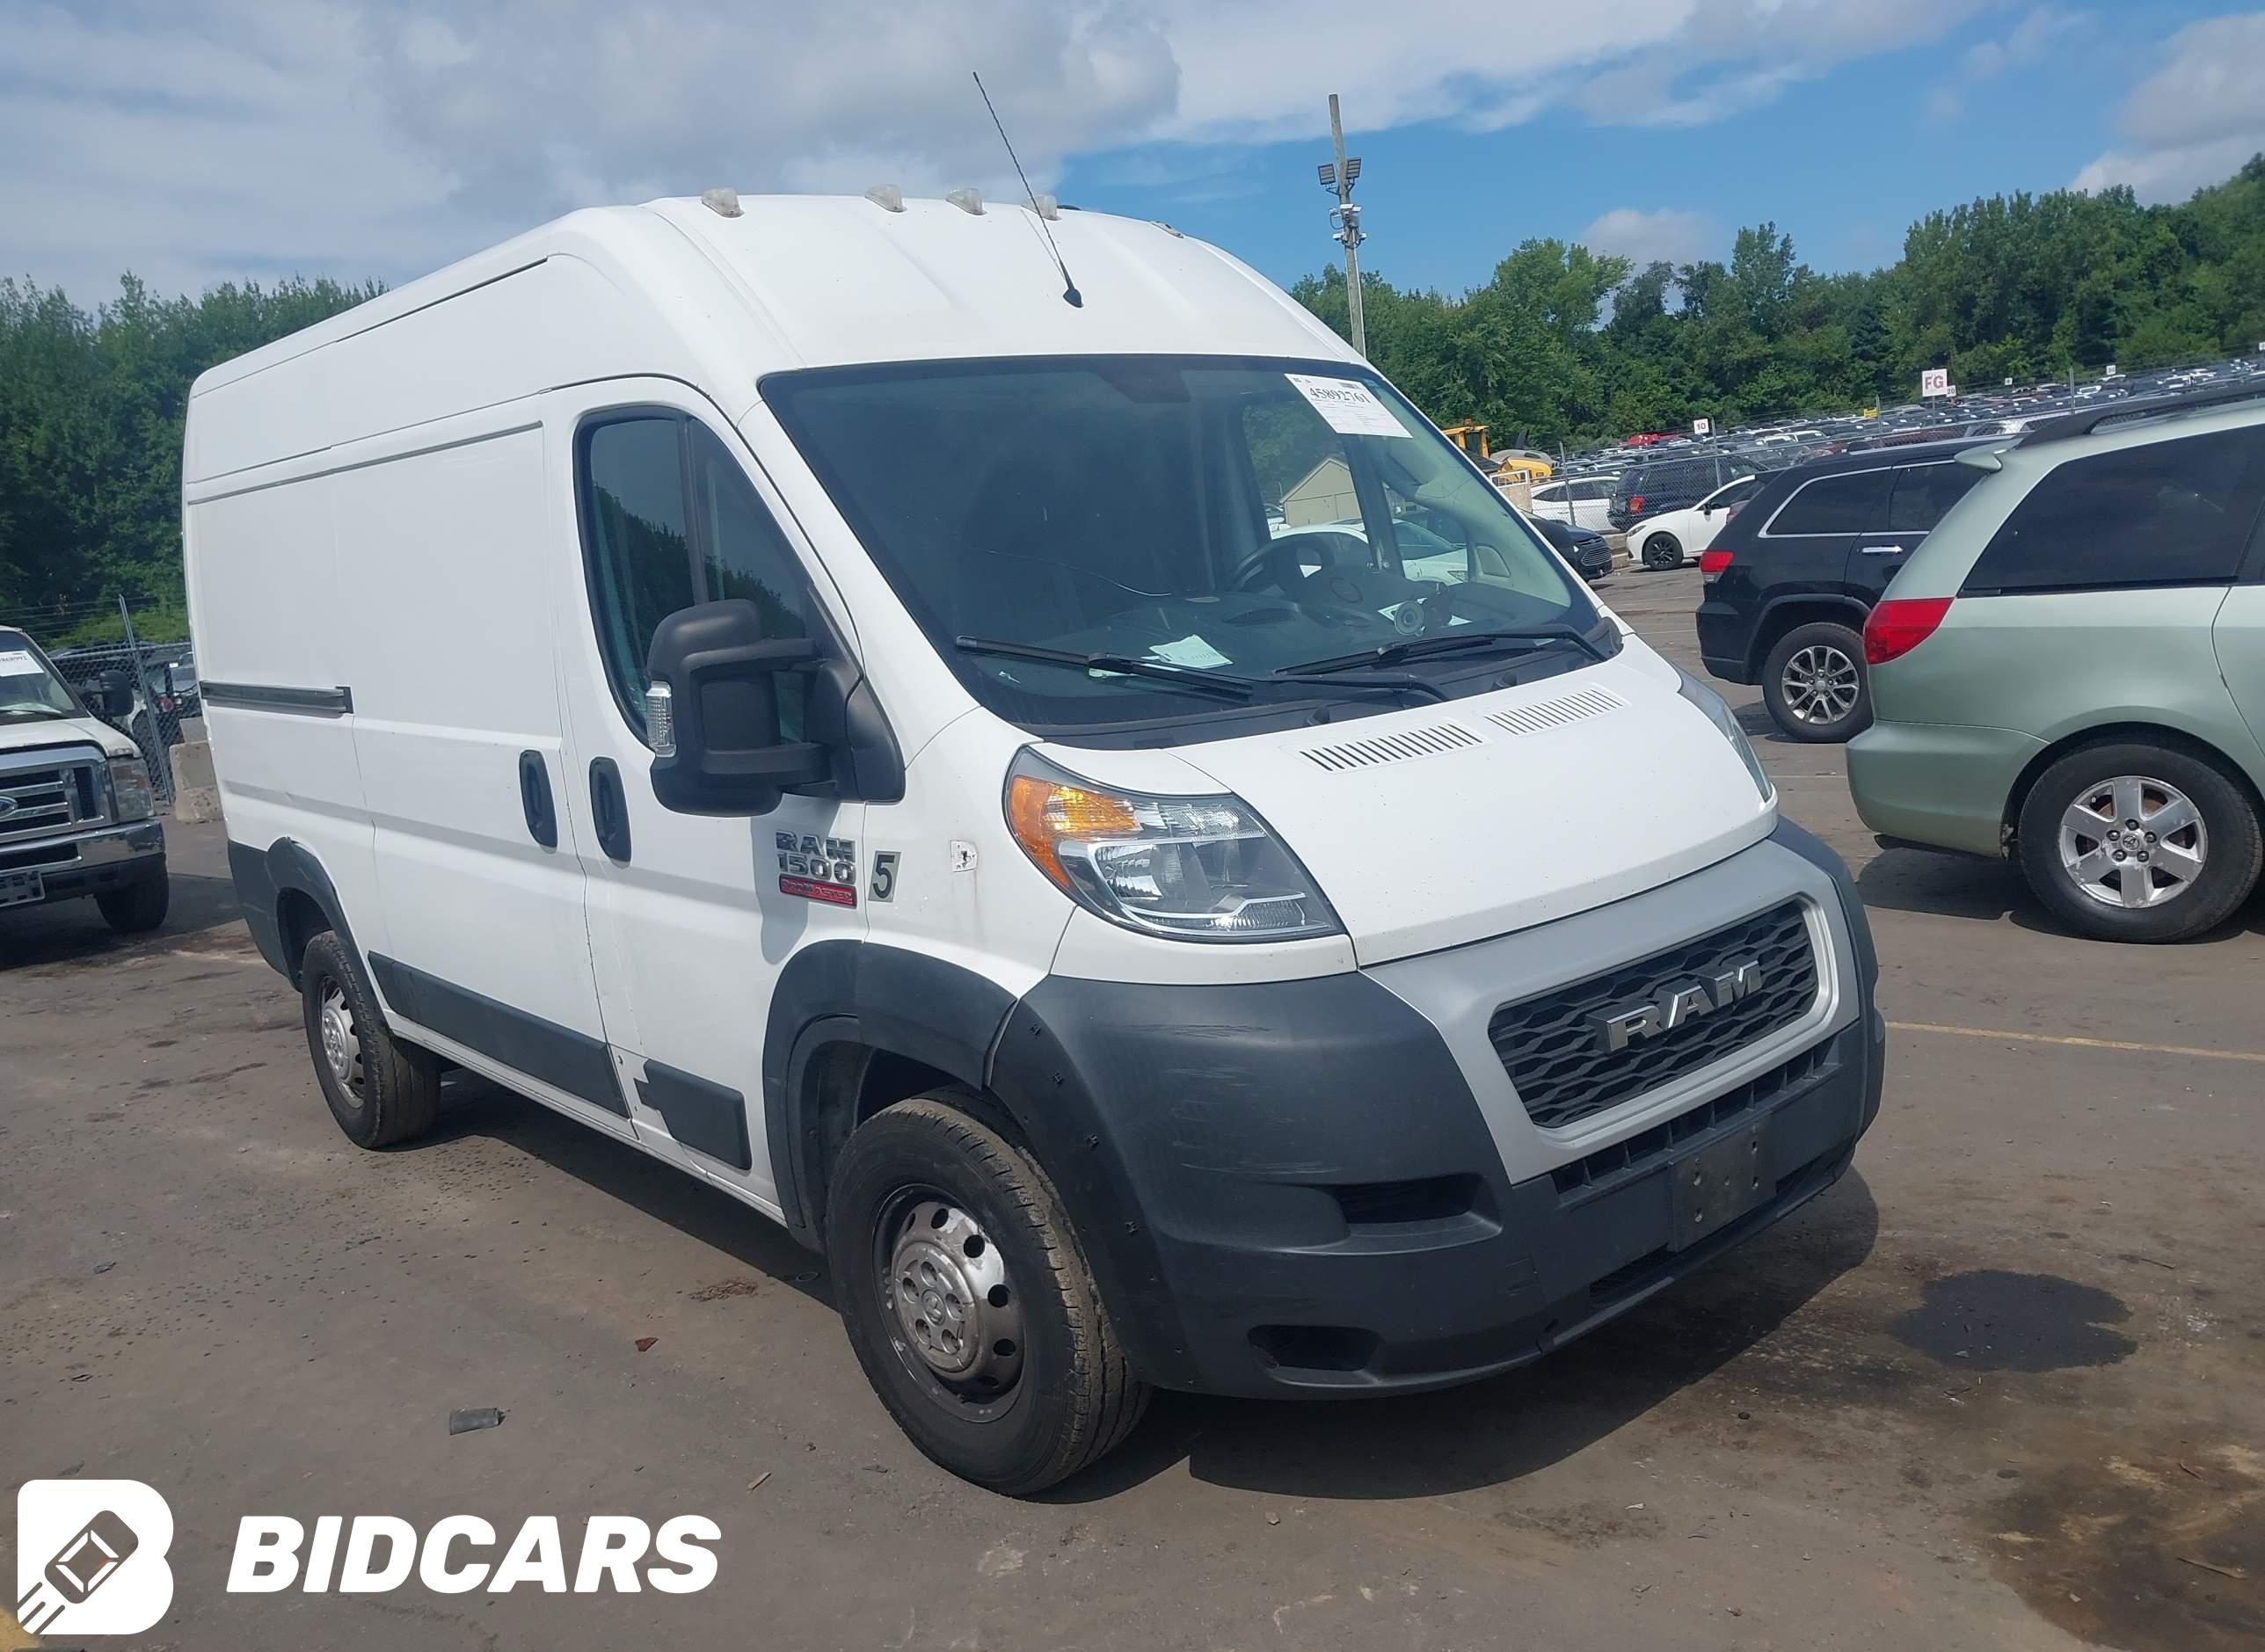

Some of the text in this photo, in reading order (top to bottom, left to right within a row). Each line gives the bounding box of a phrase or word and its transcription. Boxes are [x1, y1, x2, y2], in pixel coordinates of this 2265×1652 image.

[1309, 388, 1371, 404] 45892761
[1925, 375, 1944, 389] FG
[776, 830, 856, 862] RAM
[776, 851, 857, 884] 1500
[872, 855, 895, 899] 5
[1605, 959, 1763, 1052] RAM
